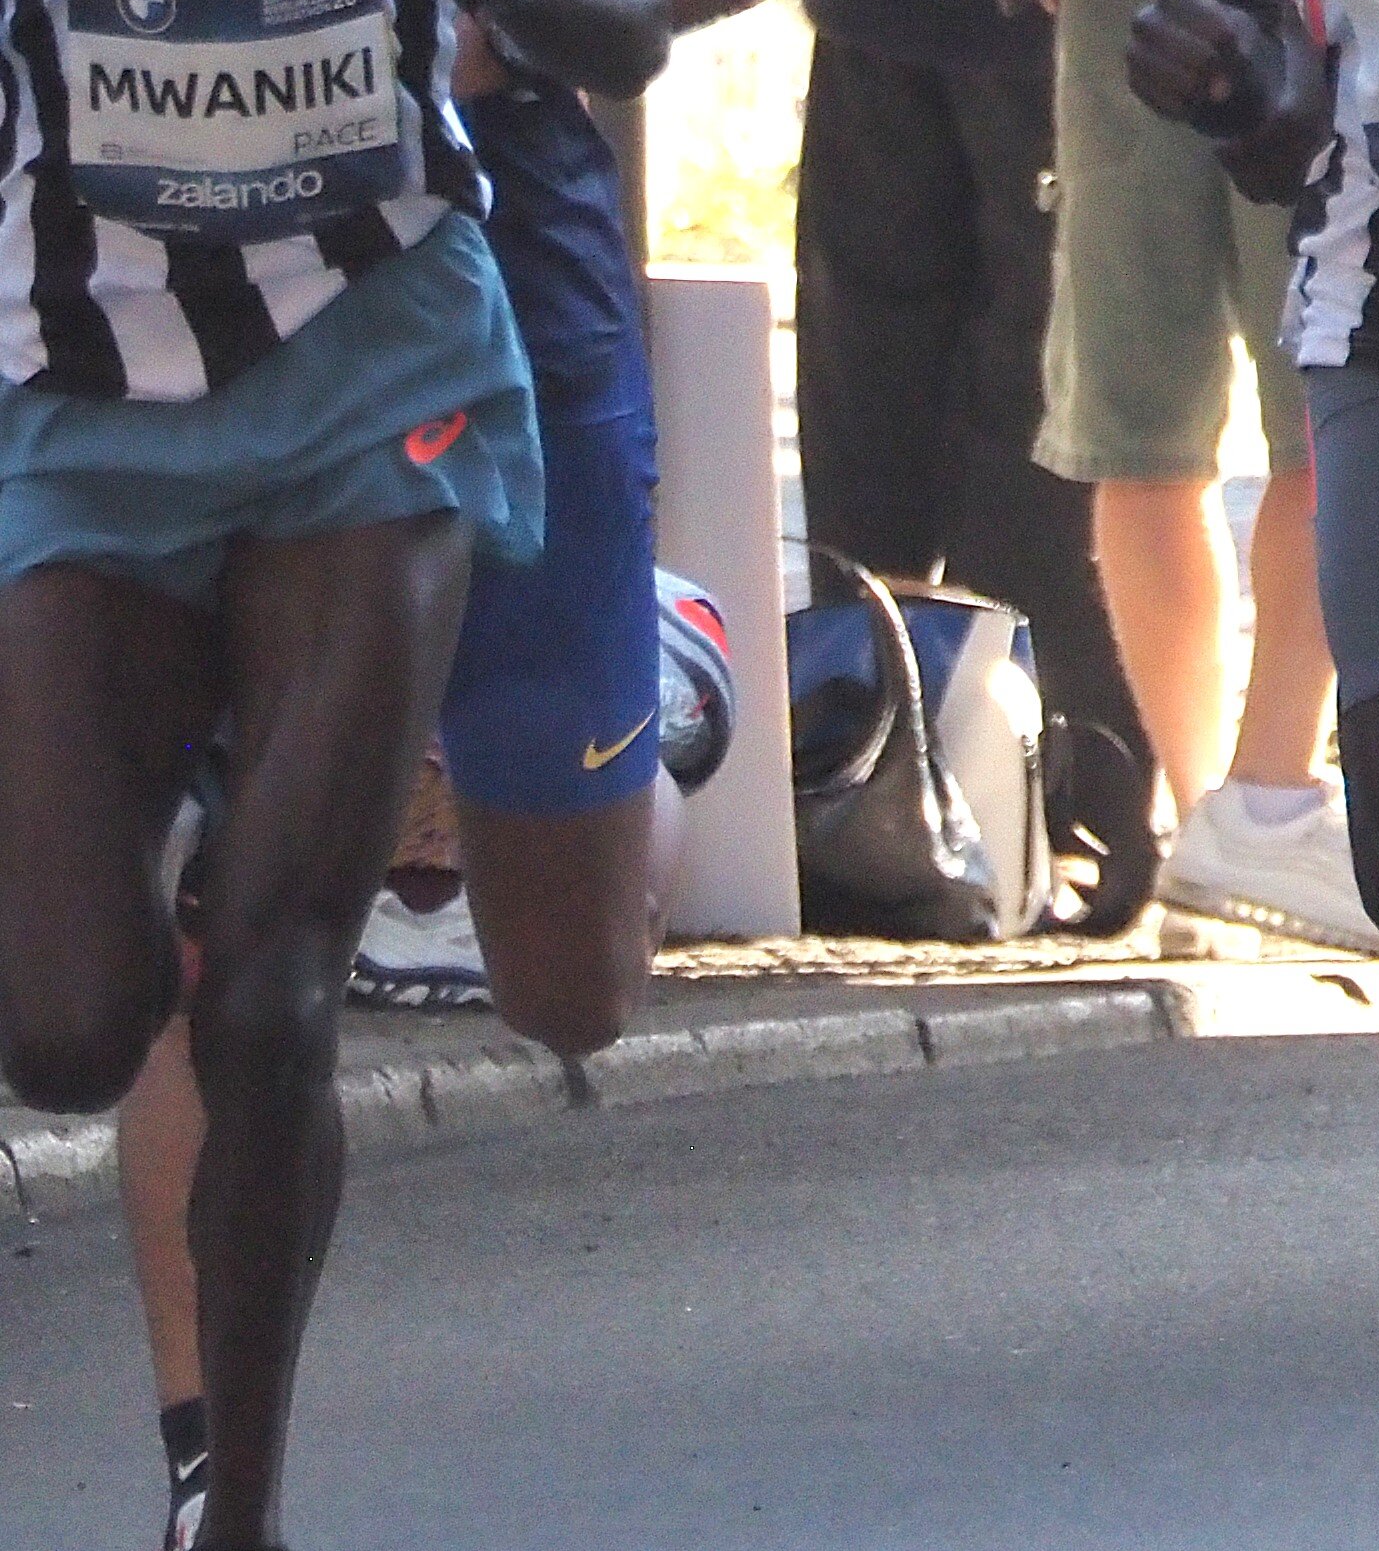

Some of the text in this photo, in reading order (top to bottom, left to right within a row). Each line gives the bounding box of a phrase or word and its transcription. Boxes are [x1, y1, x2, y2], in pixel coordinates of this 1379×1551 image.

[89, 46, 375, 119] MWANIKI
[293, 117, 379, 153] PACE
[157, 168, 323, 211] zalando
